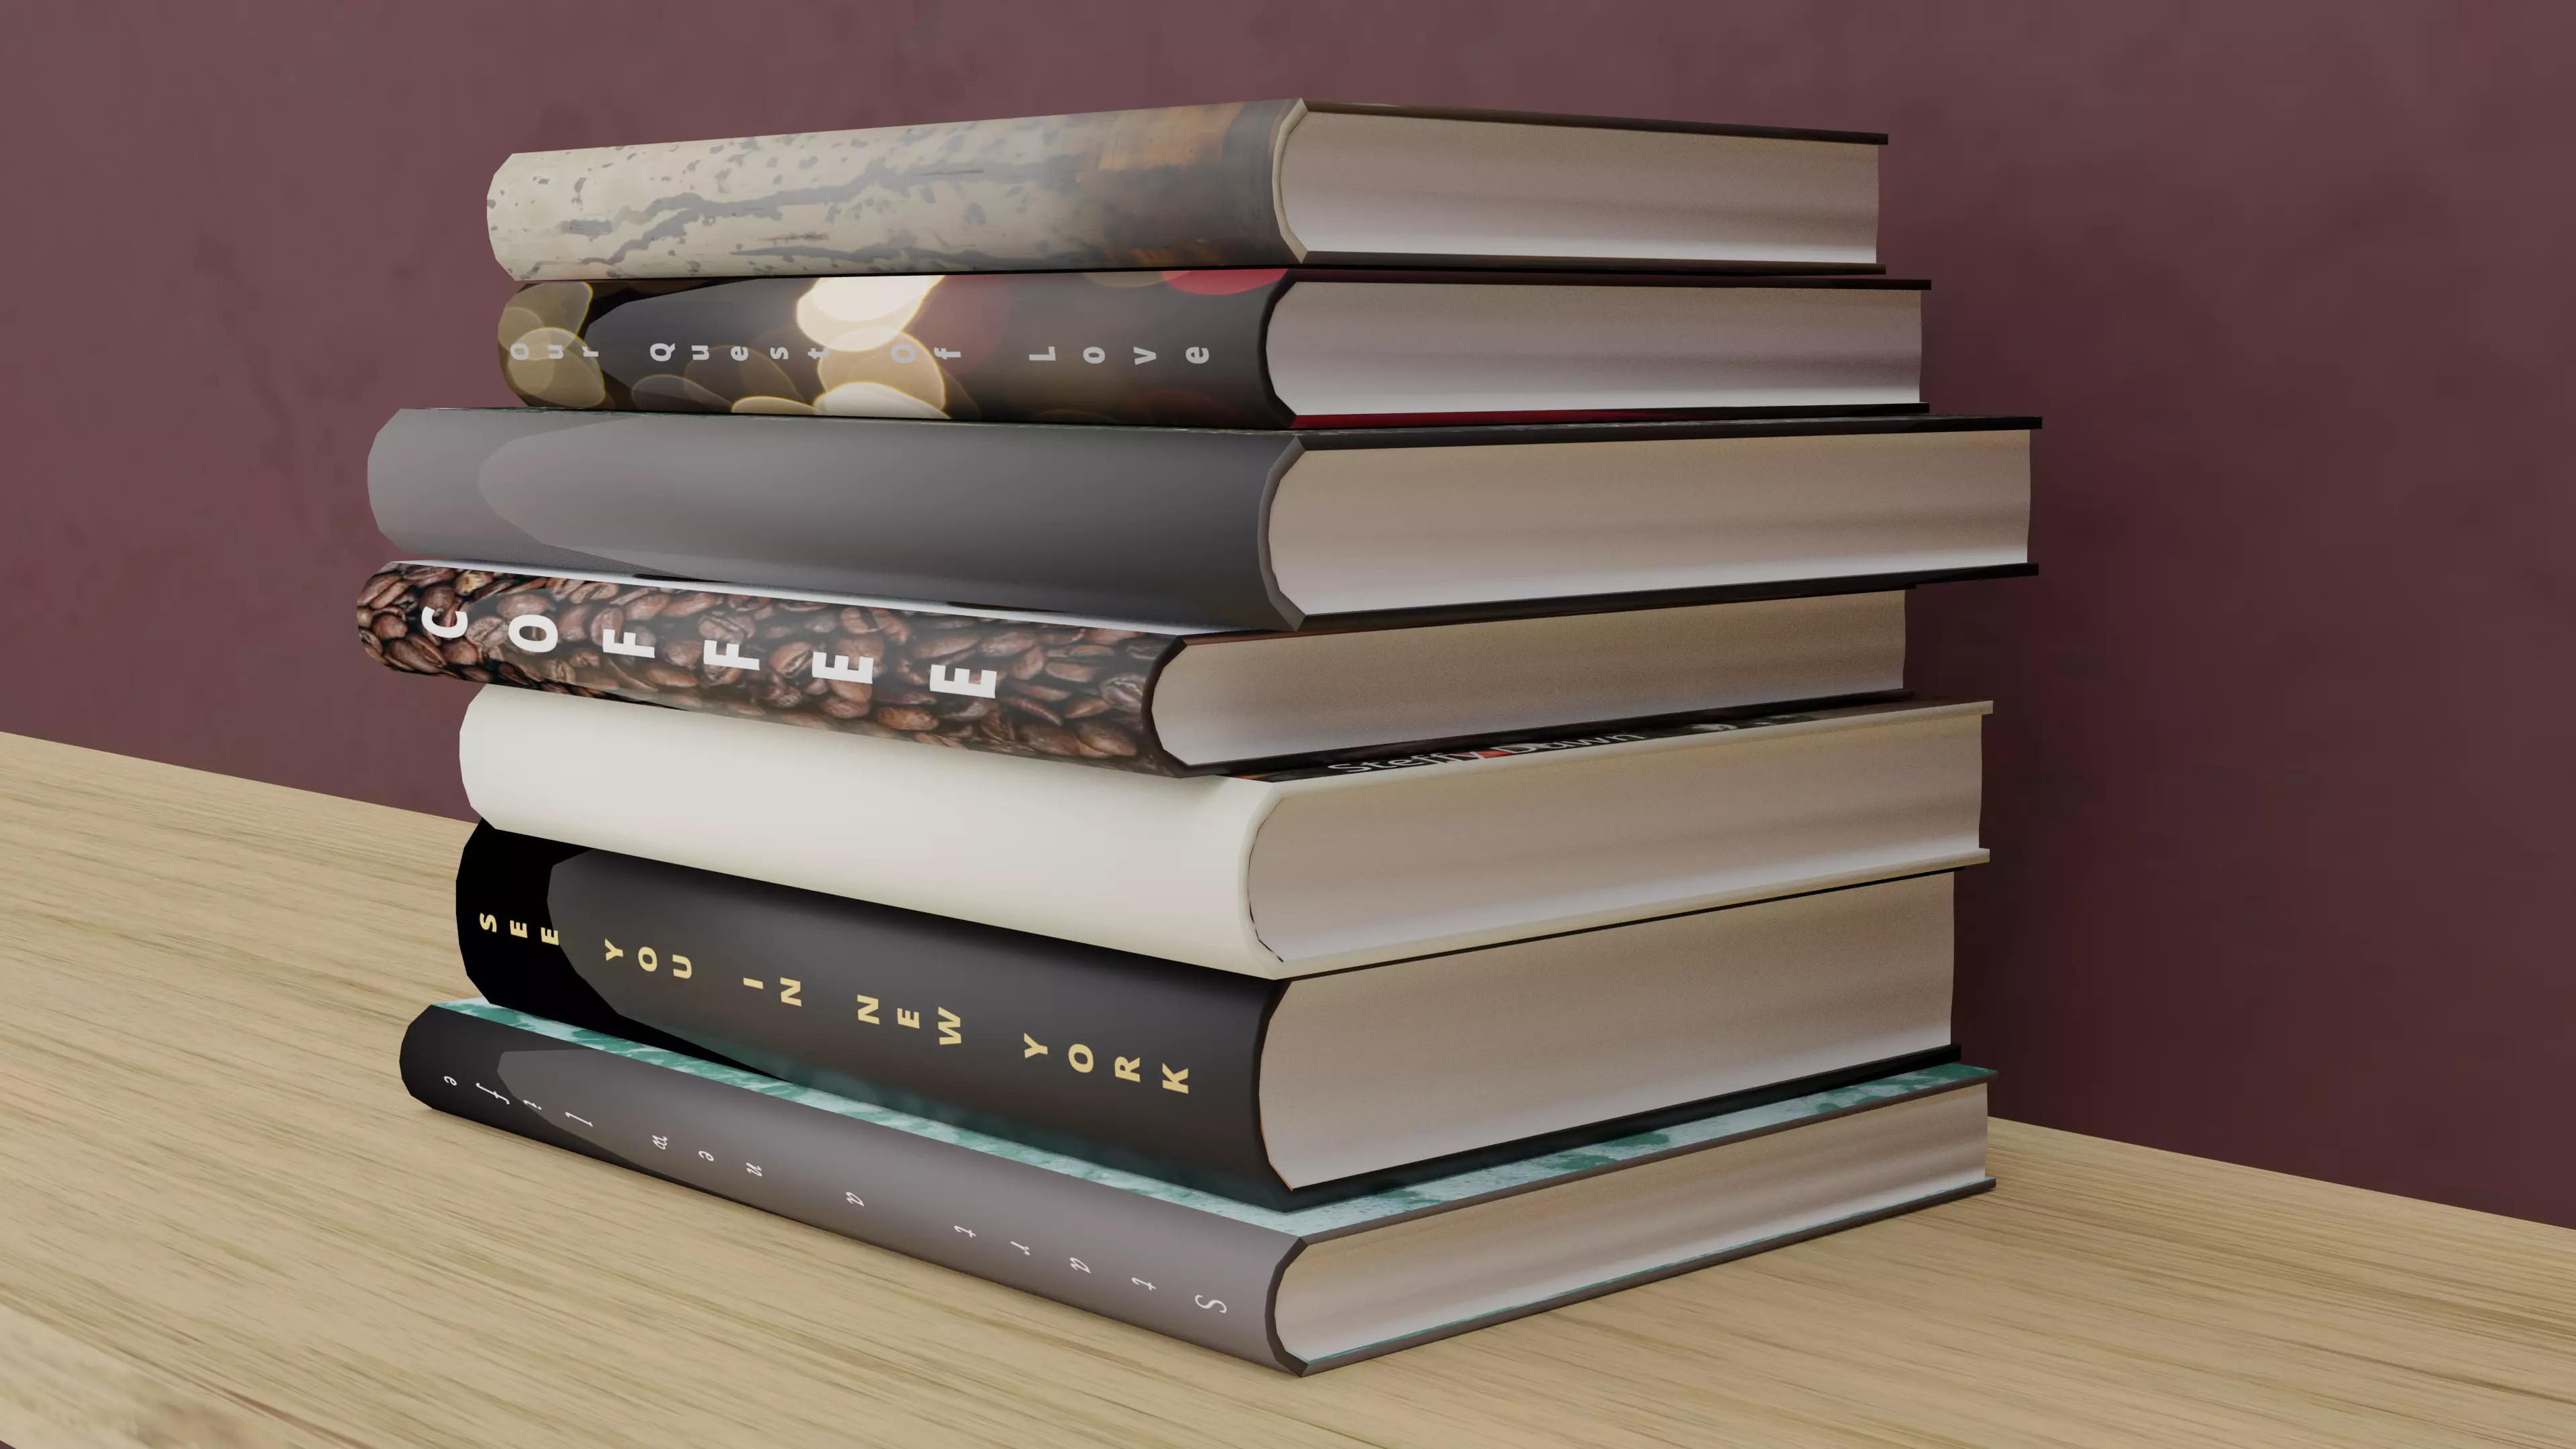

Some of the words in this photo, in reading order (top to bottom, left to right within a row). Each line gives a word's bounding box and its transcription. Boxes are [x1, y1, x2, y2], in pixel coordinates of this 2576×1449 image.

[510, 342, 598, 360] Our
[650, 343, 829, 362] Quest
[891, 344, 961, 364] Of
[1029, 346, 1210, 365] Love
[421, 606, 998, 698] COFFEE
[1328, 751, 1485, 772] Steffy
[480, 912, 559, 945] SEE
[604, 938, 692, 979] YOU
[743, 977, 802, 1006] IN
[857, 994, 962, 1045] NEW
[1024, 1033, 1189, 1094] YORK
[443, 1075, 593, 1128] life
[652, 1135, 763, 1177] new
[846, 1191, 864, 1207] a
[954, 1225, 1227, 1313] Start
